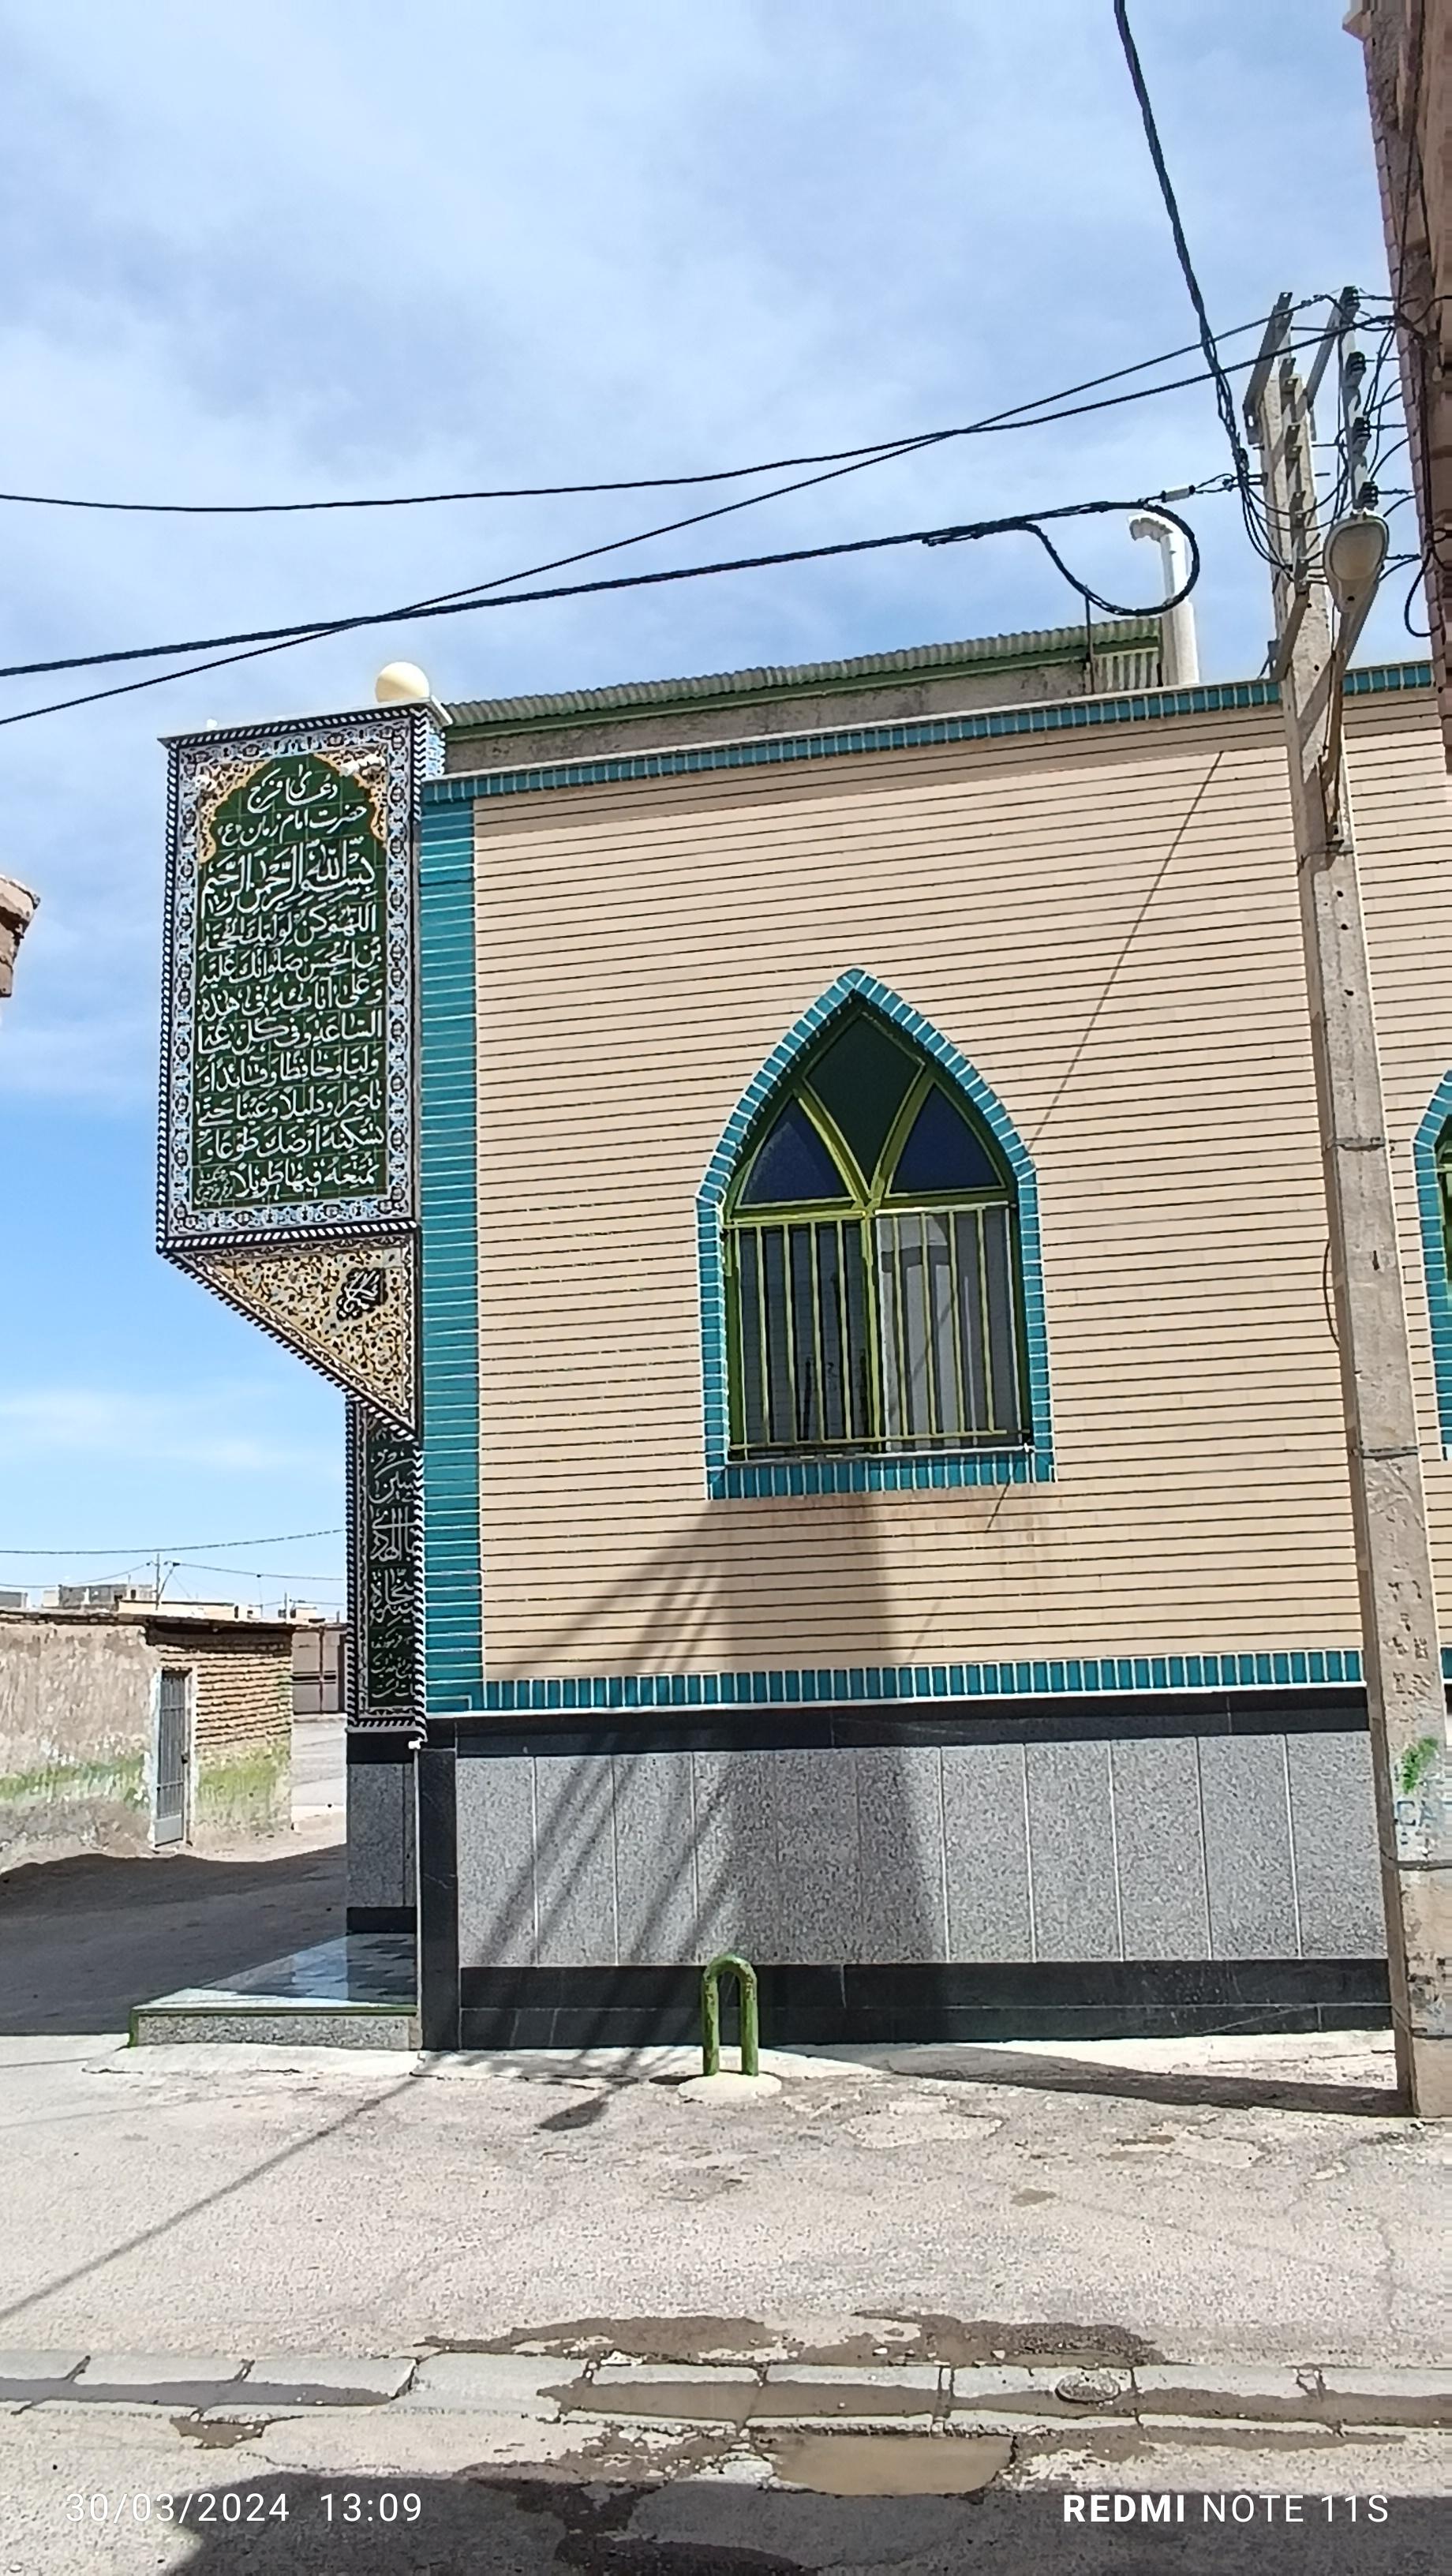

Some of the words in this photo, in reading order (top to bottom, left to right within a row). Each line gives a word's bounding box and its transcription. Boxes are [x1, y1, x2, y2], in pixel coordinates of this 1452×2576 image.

[240, 813, 283, 847] زمان
[279, 808, 309, 844] امام
[309, 805, 368, 833] حضرت
